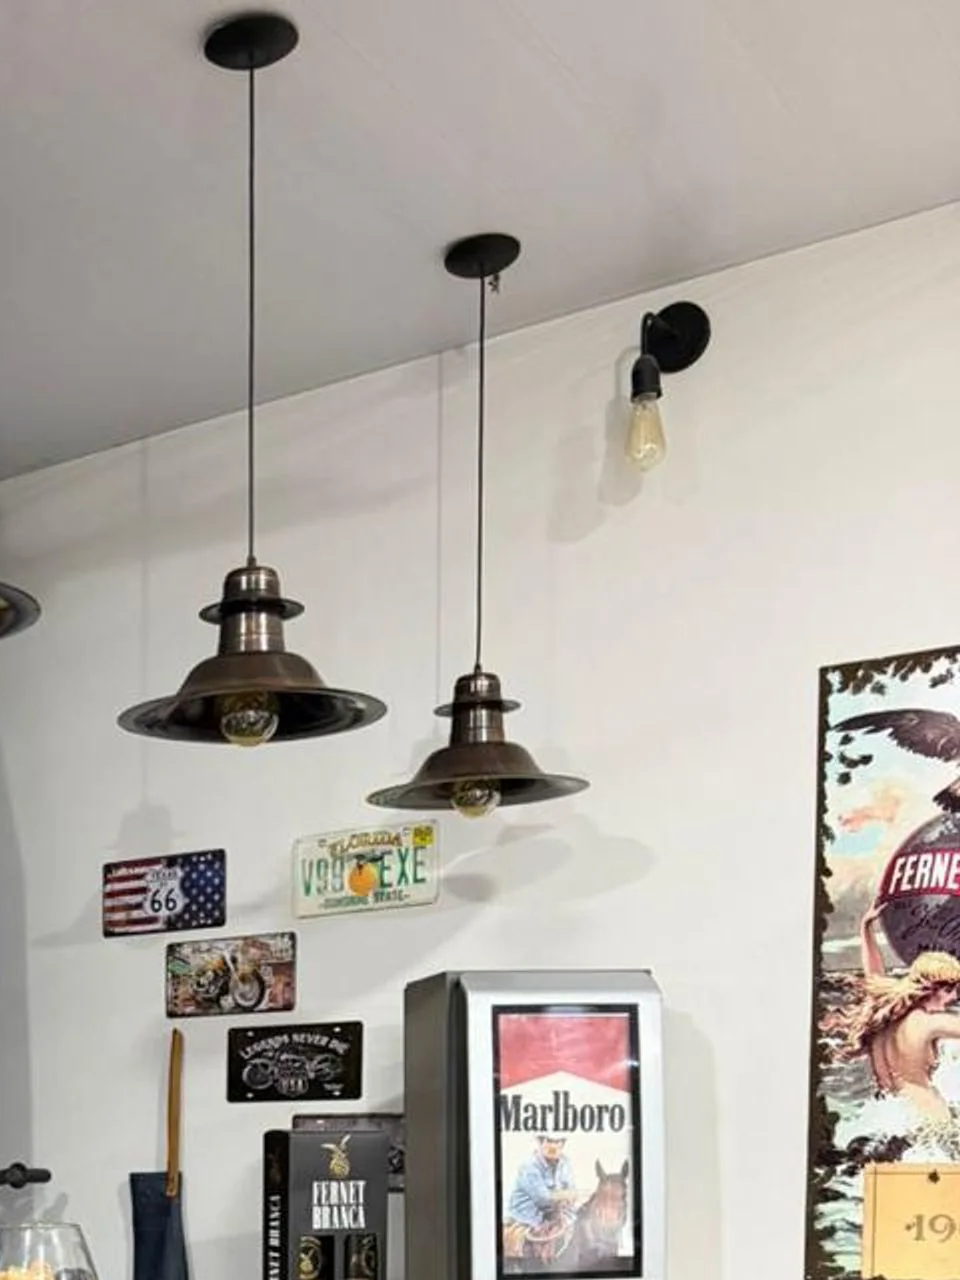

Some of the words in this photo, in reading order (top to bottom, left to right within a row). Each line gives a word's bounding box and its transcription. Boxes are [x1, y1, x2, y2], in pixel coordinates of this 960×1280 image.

[379, 845, 427, 889] EXE
[150, 888, 177, 913] 66
[499, 1090, 626, 1133] Marlboro
[311, 1180, 367, 1205] FERNET
[311, 1205, 367, 1230] BRANCA
[912, 1213, 960, 1243] 19
